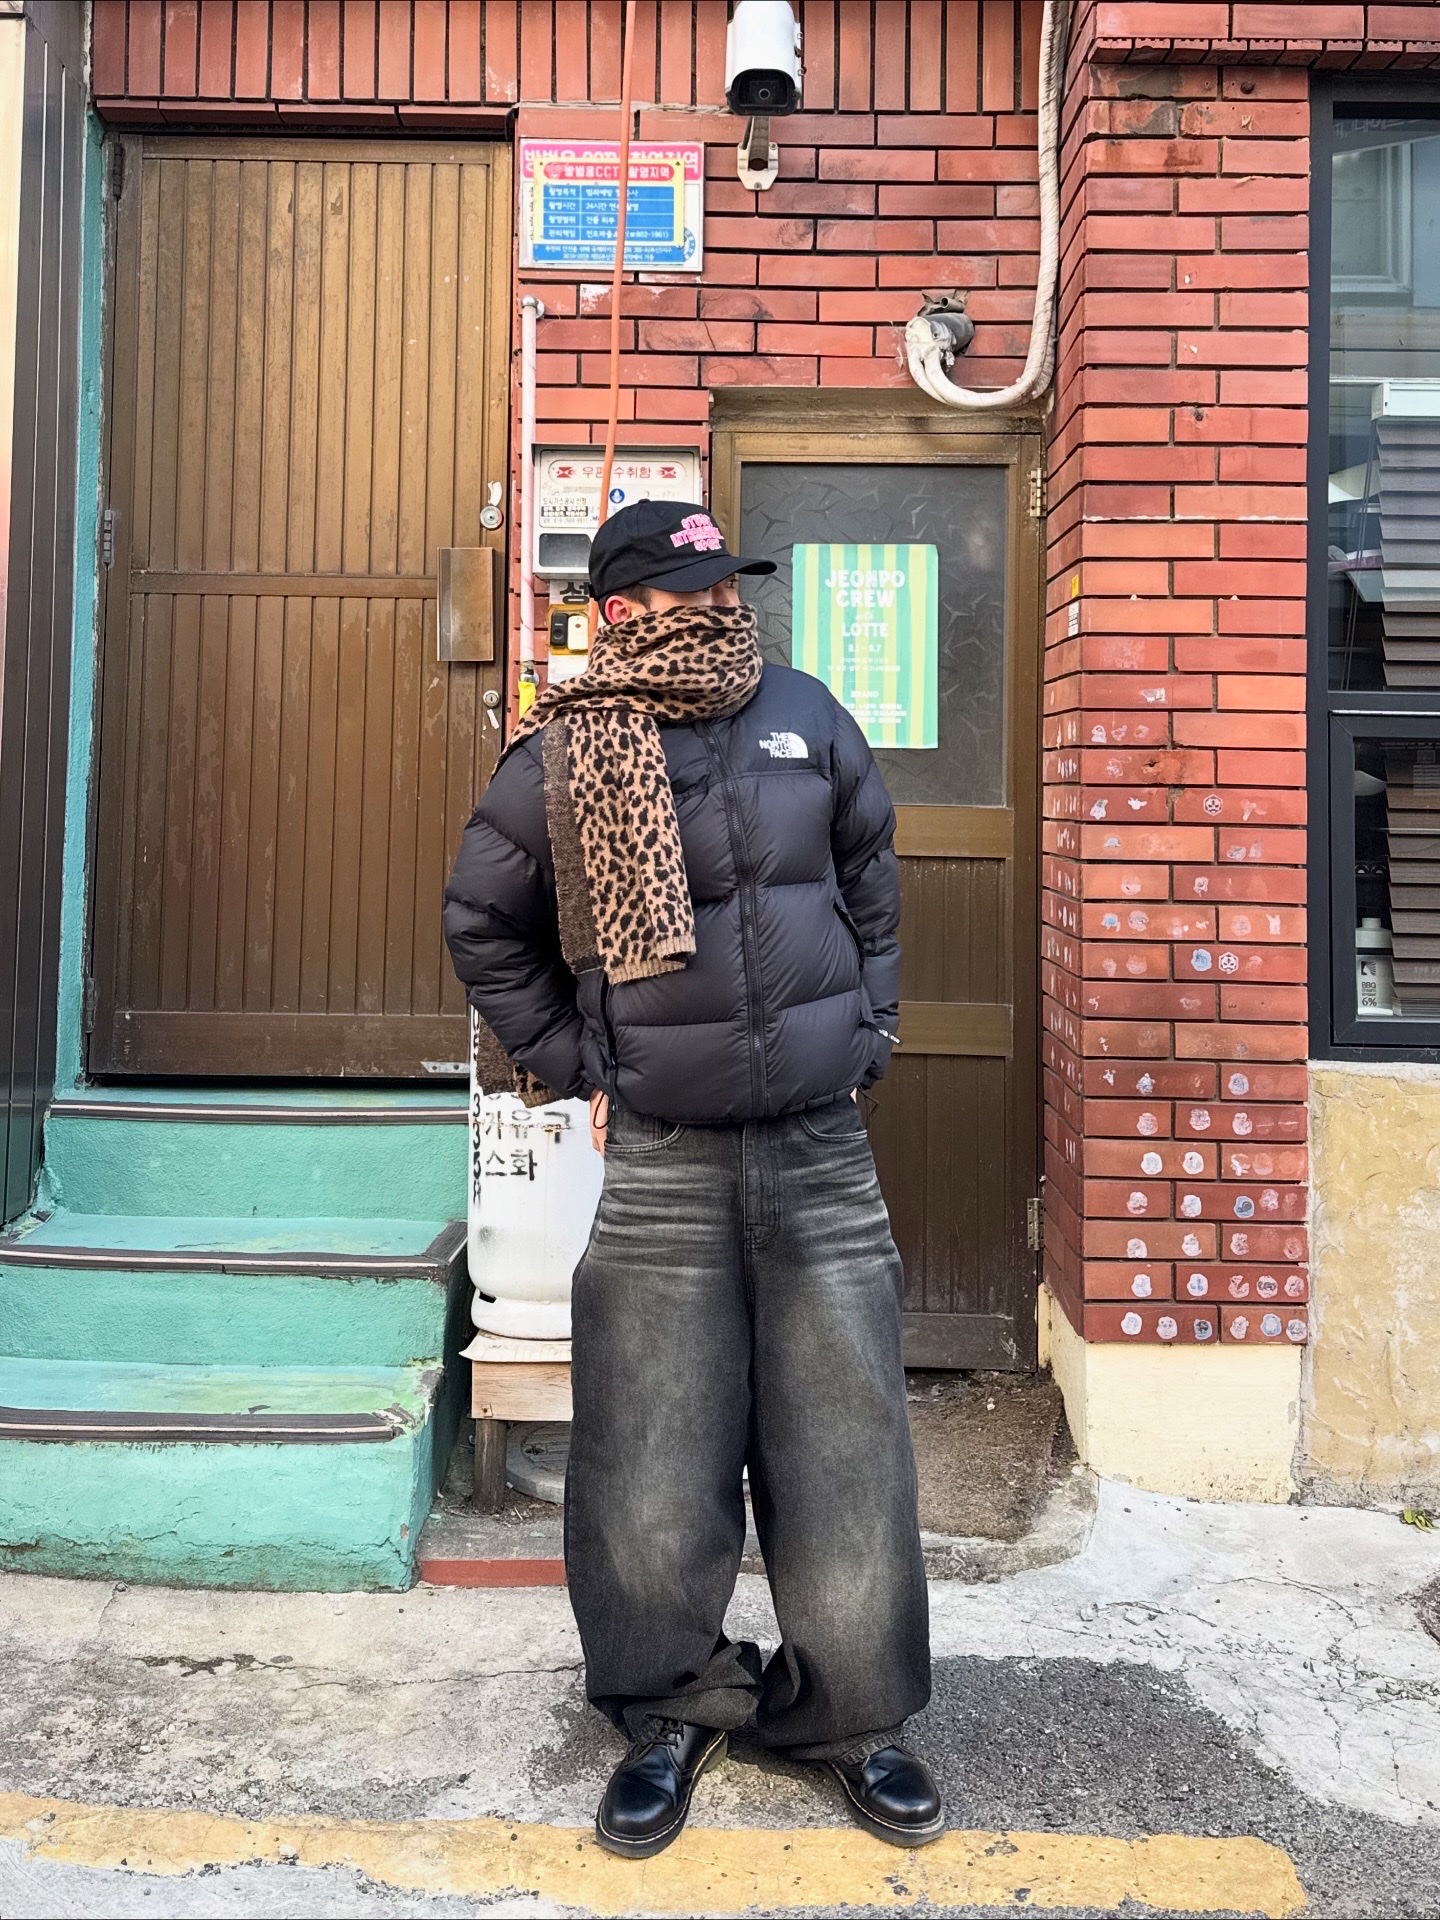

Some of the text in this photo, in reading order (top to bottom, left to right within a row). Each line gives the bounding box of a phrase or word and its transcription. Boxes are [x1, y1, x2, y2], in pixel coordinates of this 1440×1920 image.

[614, 466, 651, 478] 수취함
[825, 570, 905, 588] JEONPO
[836, 590, 894, 607] CREW
[841, 622, 889, 637] LOTTE
[770, 732, 789, 741] THE
[758, 740, 790, 750] NORTH
[770, 750, 793, 758] FACE
[1361, 997, 1377, 1007] 6%
